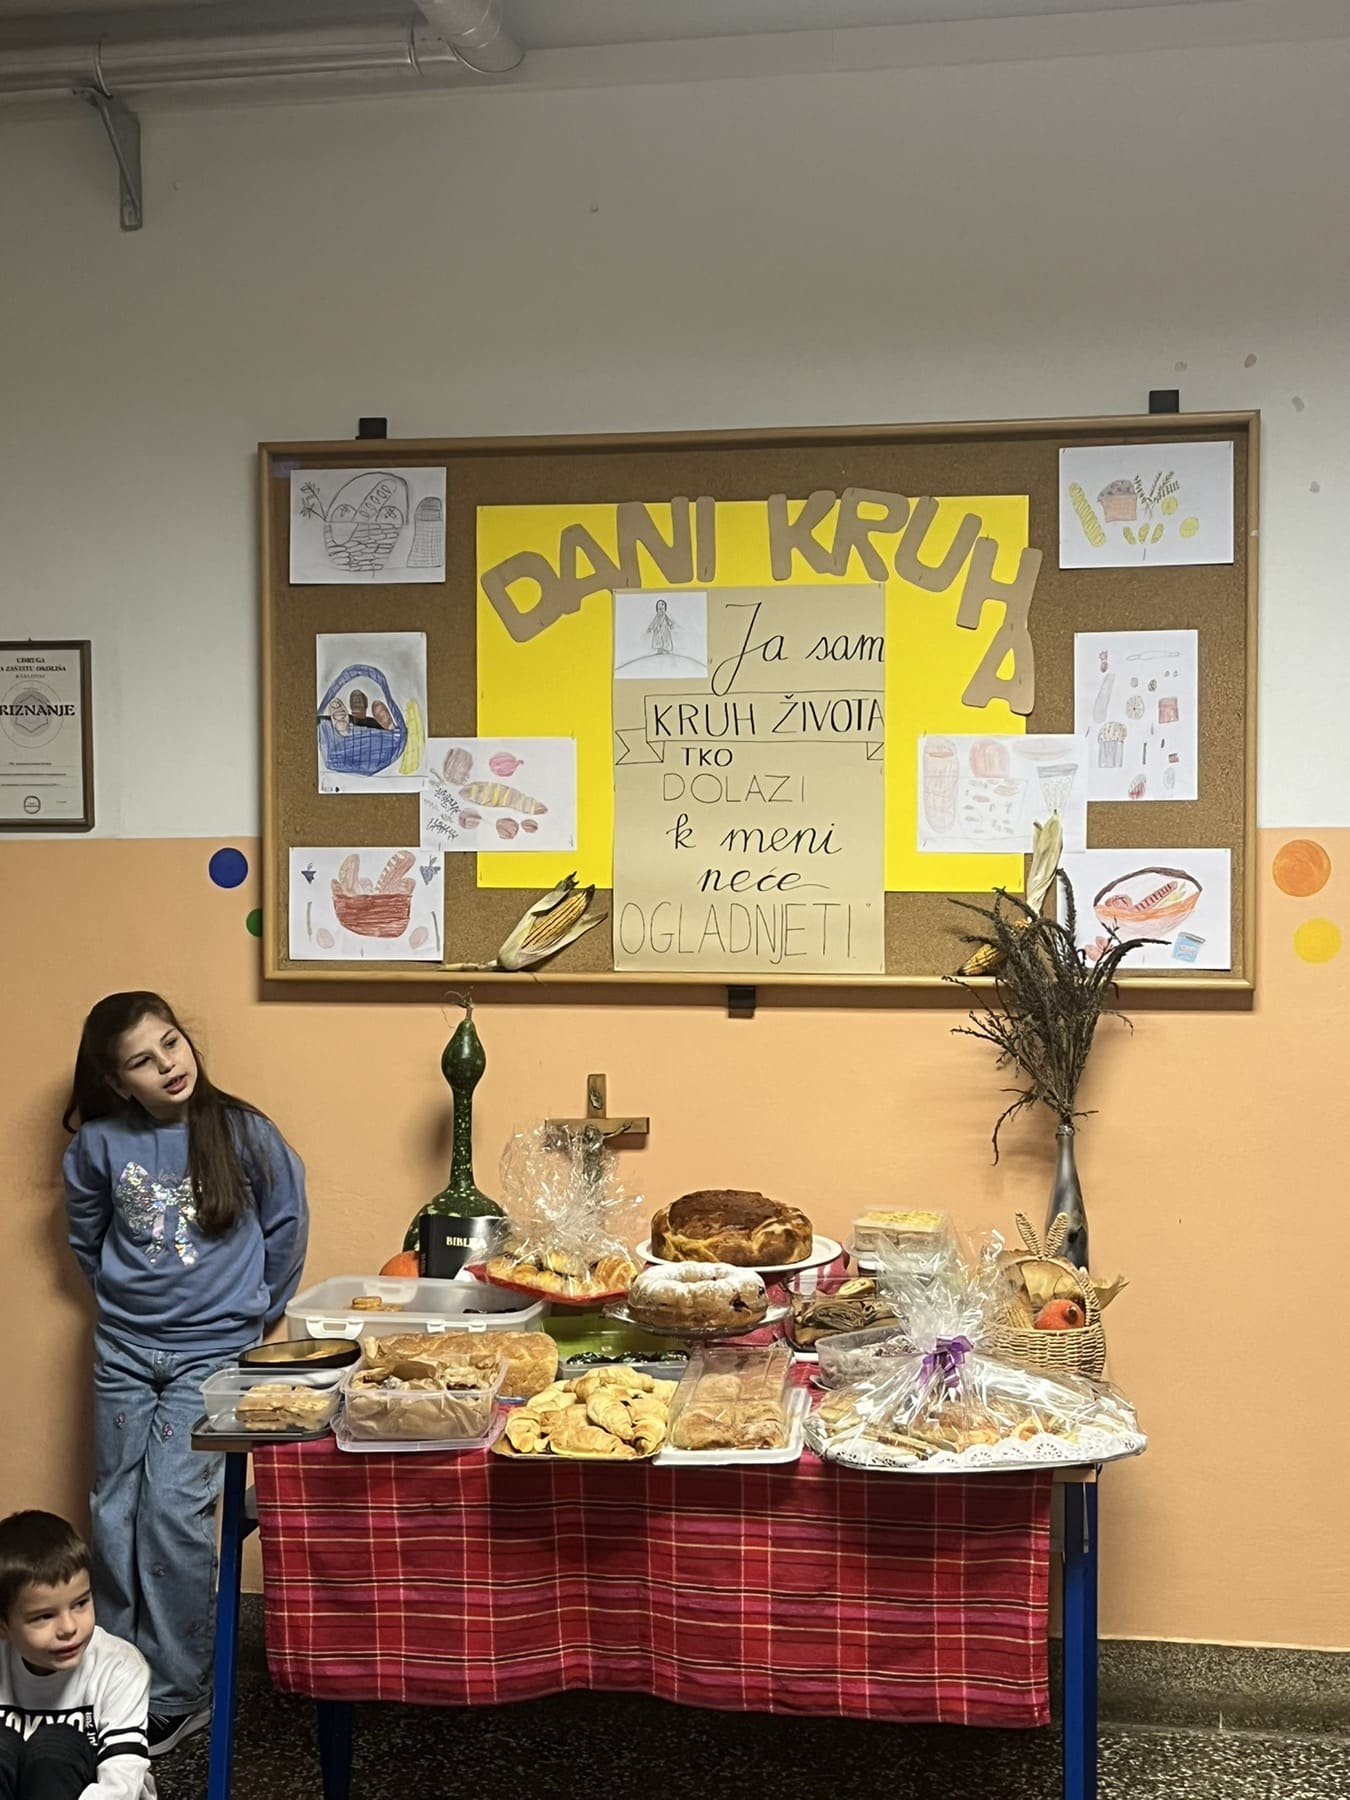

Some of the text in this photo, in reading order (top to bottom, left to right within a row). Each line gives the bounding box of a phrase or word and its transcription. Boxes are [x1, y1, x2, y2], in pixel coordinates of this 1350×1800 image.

[481, 487, 1043, 716] DANI KRUHA
[805, 634, 884, 662] sam
[654, 693, 884, 737] KRUH ŽIVOTA
[680, 747, 733, 767] TKO
[663, 773, 805, 804] DOLAZI
[666, 813, 842, 855] k meni
[697, 867, 830, 893] neće
